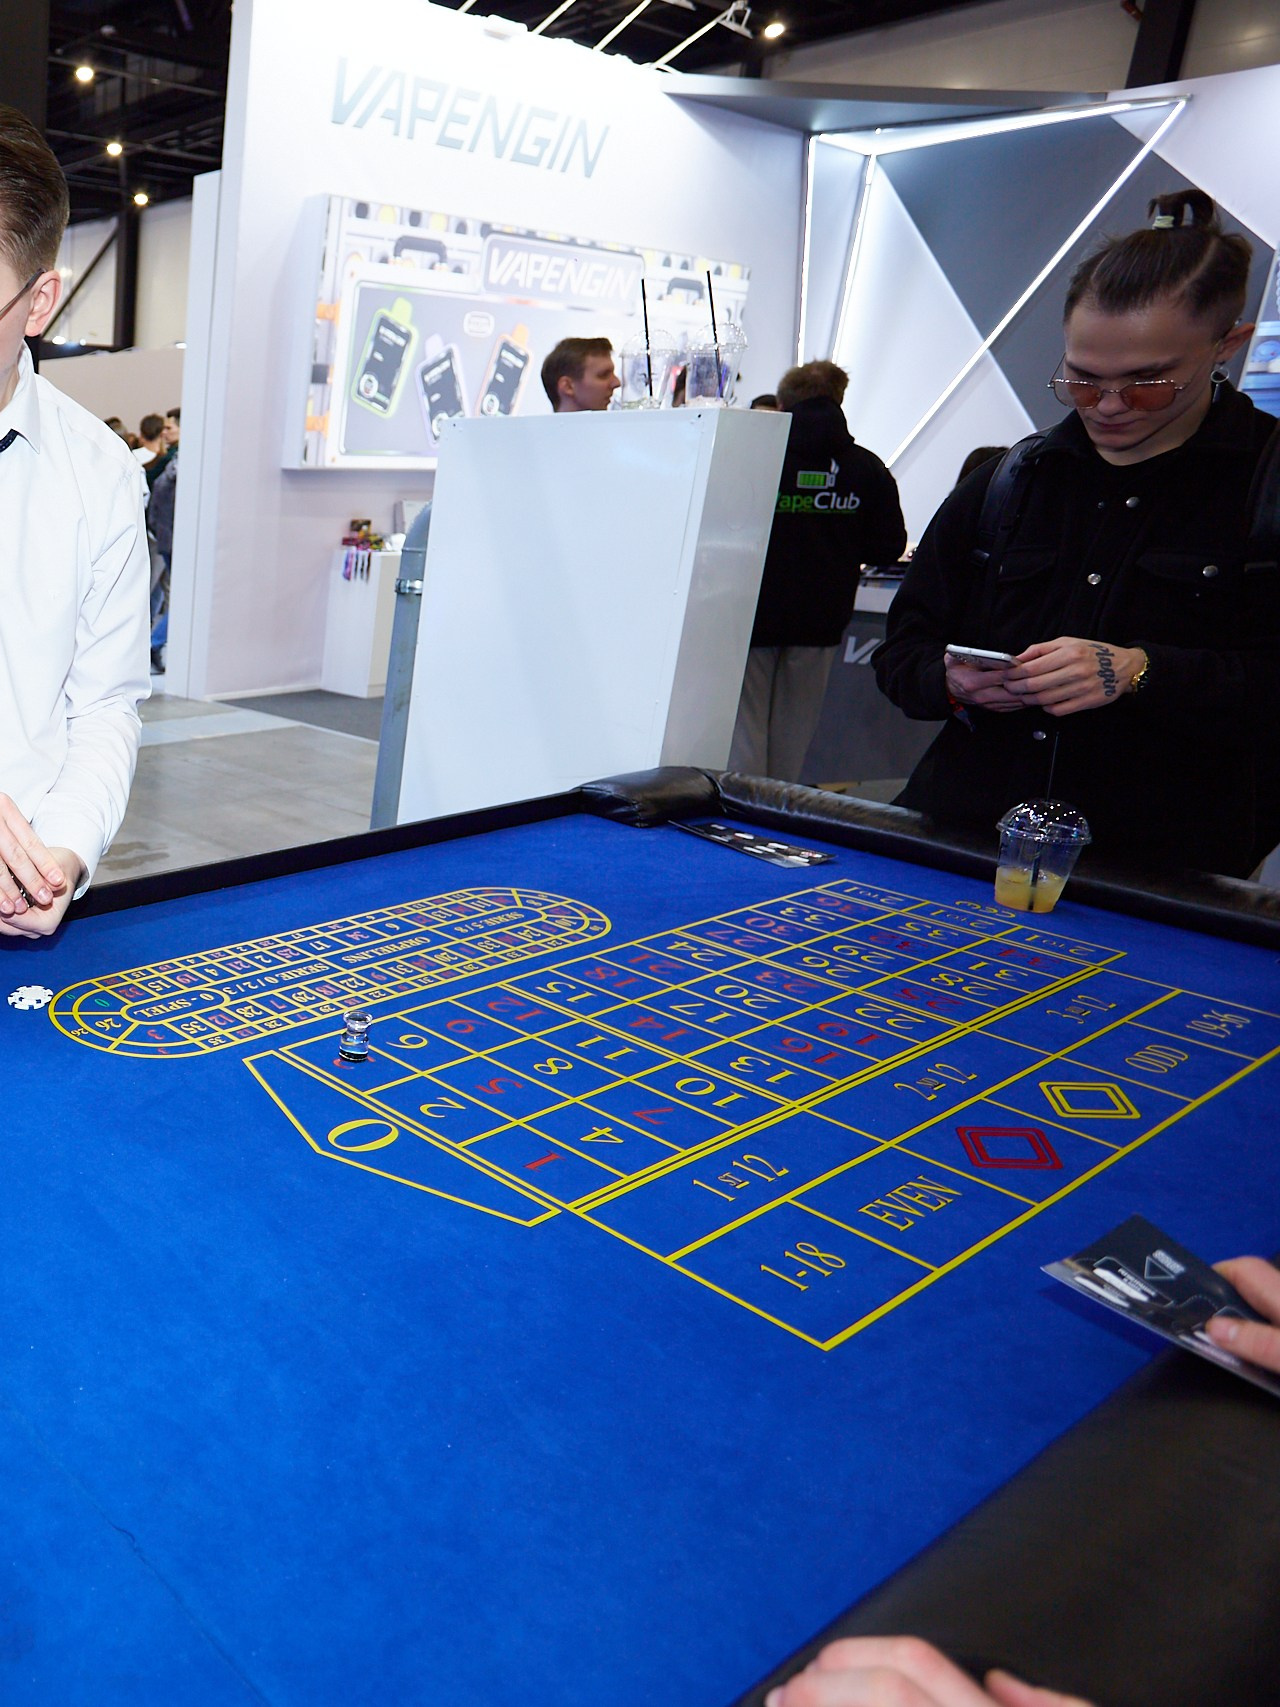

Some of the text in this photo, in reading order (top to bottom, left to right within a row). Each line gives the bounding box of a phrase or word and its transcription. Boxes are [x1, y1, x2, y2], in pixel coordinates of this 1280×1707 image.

[331, 55, 610, 179] VAPENGIN
[488, 247, 637, 300] VAPENGIN
[778, 491, 861, 513] apeClub
[843, 886, 860, 894] 1
[816, 896, 869, 913] 36
[880, 895, 905, 905] 2
[431, 910, 453, 919] 13
[779, 906, 836, 925] 33
[930, 908, 946, 917] 1
[385, 922, 401, 932] 6
[517, 928, 541, 939] 24
[744, 916, 805, 936] 30
[897, 921, 960, 941] 35
[970, 919, 996, 930] 2
[291, 932, 306, 940] 17
[346, 930, 370, 941] 34
[705, 929, 768, 948] 27
[869, 930, 929, 950] 32
[1024, 934, 1040, 942] 1
[276, 948, 301, 959] 25
[309, 940, 332, 951] 17
[341, 935, 431, 964] ORPHELINS
[477, 940, 501, 950] 33
[666, 941, 727, 962] 24
[1068, 945, 1097, 956] 2
[254, 954, 272, 964] 2
[433, 951, 459, 963] 20
[832, 944, 896, 965] 29
[997, 947, 1062, 970] 34
[203, 967, 219, 977] 4
[225, 959, 252, 971] 21
[275, 962, 330, 981] SERIE
[387, 964, 414, 975] 31
[627, 953, 686, 975] 21
[794, 955, 862, 979] 26
[968, 960, 1030, 982] 31
[131, 970, 148, 980] 15
[176, 973, 200, 985] 19
[339, 977, 366, 989] 22
[370, 971, 387, 981] 9
[584, 966, 643, 988] 18
[754, 970, 821, 995] 23
[118, 986, 145, 999] 32
[147, 979, 172, 992] 15
[314, 984, 341, 996] 18
[369, 988, 386, 999] 22
[535, 981, 598, 1004] 15
[930, 972, 999, 997] 28
[94, 998, 111, 1008] 0
[199, 993, 215, 1002] 0
[269, 999, 288, 1010] 7
[291, 990, 316, 1003] 29
[714, 984, 782, 1009] 20
[892, 986, 966, 1012] 25
[1071, 994, 1117, 1012] 12
[133, 998, 193, 1018] SPIEL
[235, 1005, 263, 1018] 28
[487, 996, 548, 1021] 12
[669, 1002, 736, 1024] 17
[855, 1002, 927, 1030] 22
[94, 1017, 122, 1032] 26
[180, 1021, 208, 1035] 35
[207, 1013, 236, 1026] 12
[263, 1019, 282, 1029] 28
[445, 1018, 487, 1034] 9
[628, 1015, 694, 1042] 14
[1186, 1009, 1252, 1039] 19-36
[70, 1027, 89, 1037] 26
[146, 1029, 166, 1041] 3
[207, 1036, 227, 1046] 35
[236, 1028, 255, 1037] 12
[385, 1033, 429, 1049] 6
[817, 1021, 884, 1046] 19
[576, 1034, 638, 1061] 11
[771, 1037, 846, 1066] 16
[533, 1057, 574, 1075] 8
[1124, 1043, 1190, 1074] ODD
[729, 1055, 799, 1085] 13
[926, 1062, 978, 1085] 12
[475, 1077, 524, 1095] 5
[675, 1076, 750, 1110] 10
[419, 1096, 467, 1118] 2
[631, 1106, 675, 1126] 7
[327, 1118, 400, 1152] 0
[579, 1126, 625, 1145] 4
[522, 1149, 567, 1173] 1
[732, 1153, 790, 1183] 12
[857, 1174, 963, 1233] EVEN
[760, 1242, 847, 1292] 1-18
